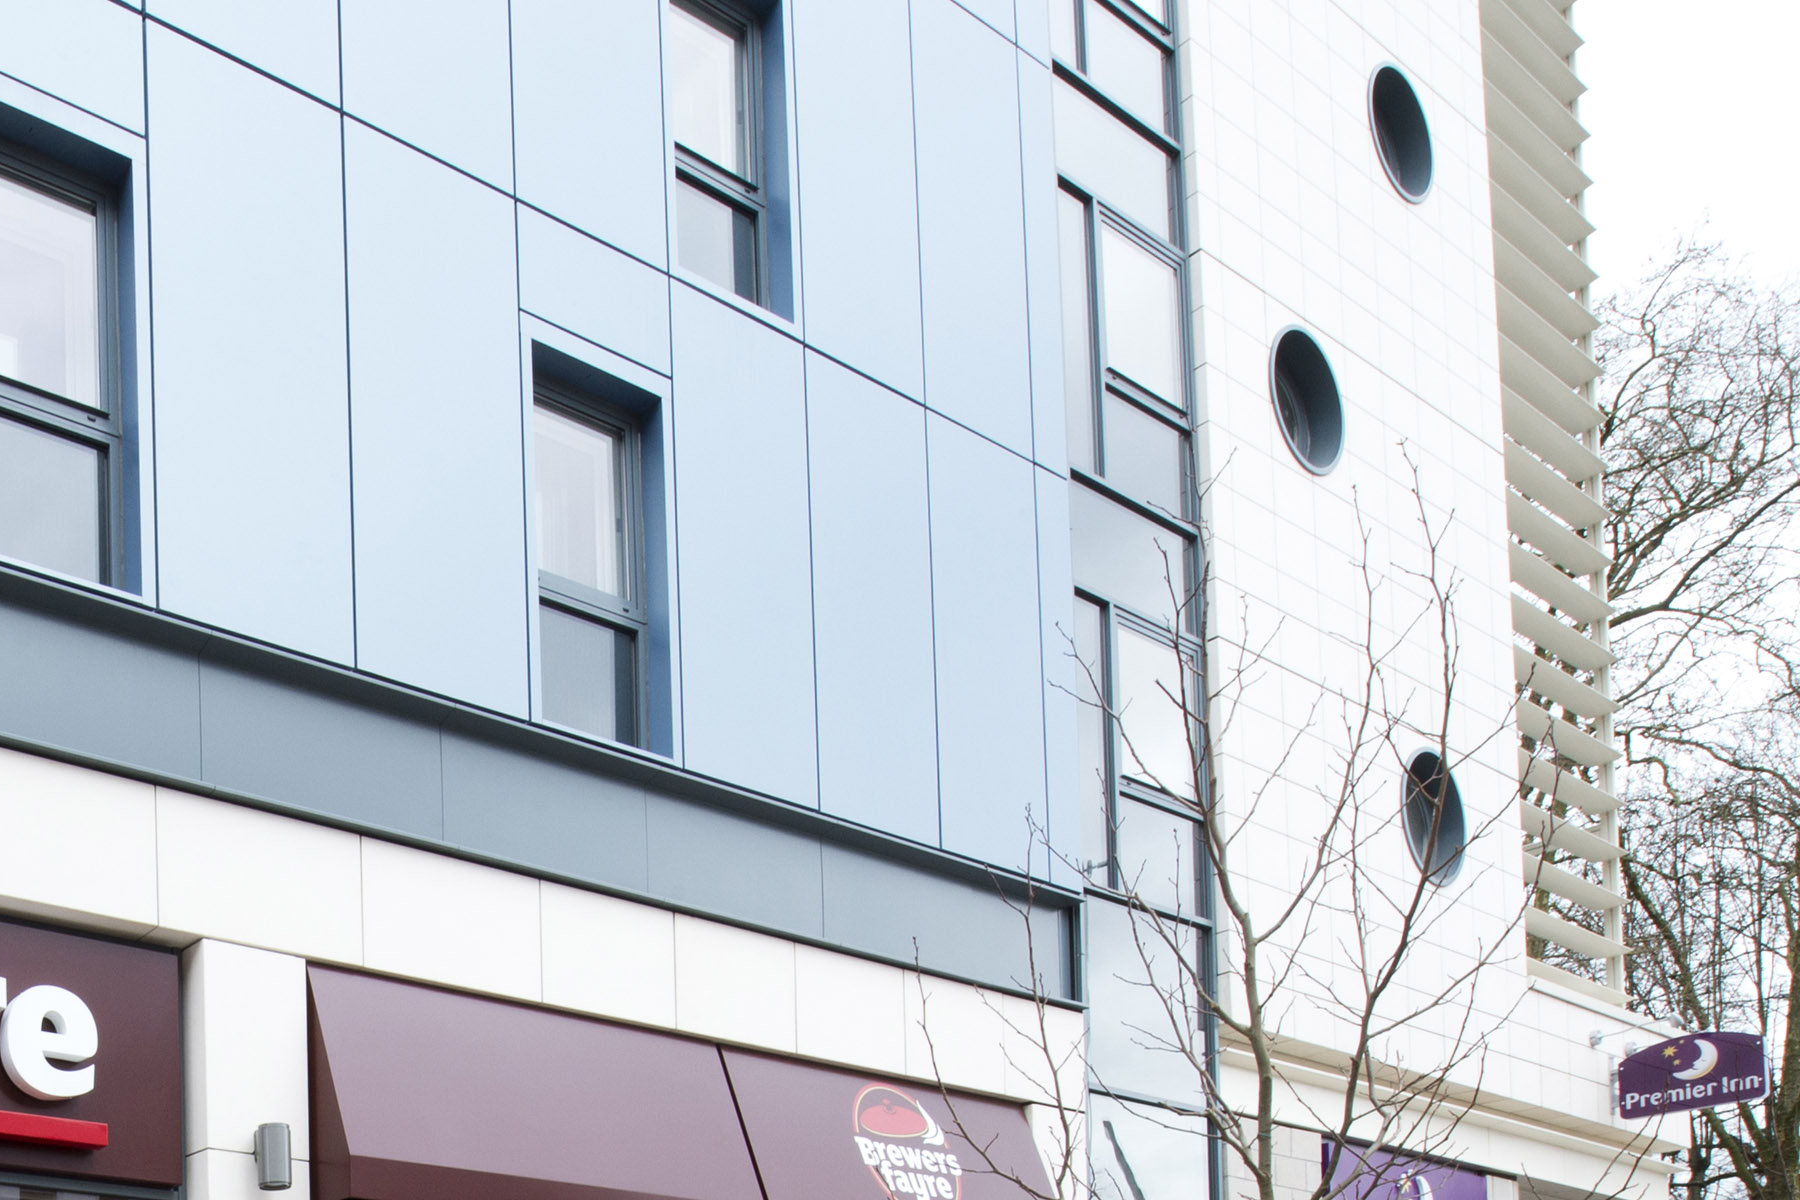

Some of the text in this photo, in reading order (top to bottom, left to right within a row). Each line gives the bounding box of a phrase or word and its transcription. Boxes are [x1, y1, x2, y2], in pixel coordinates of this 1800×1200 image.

[1625, 1075, 1760, 1110] Premier Inn
[854, 1136, 963, 1176] Brewers
